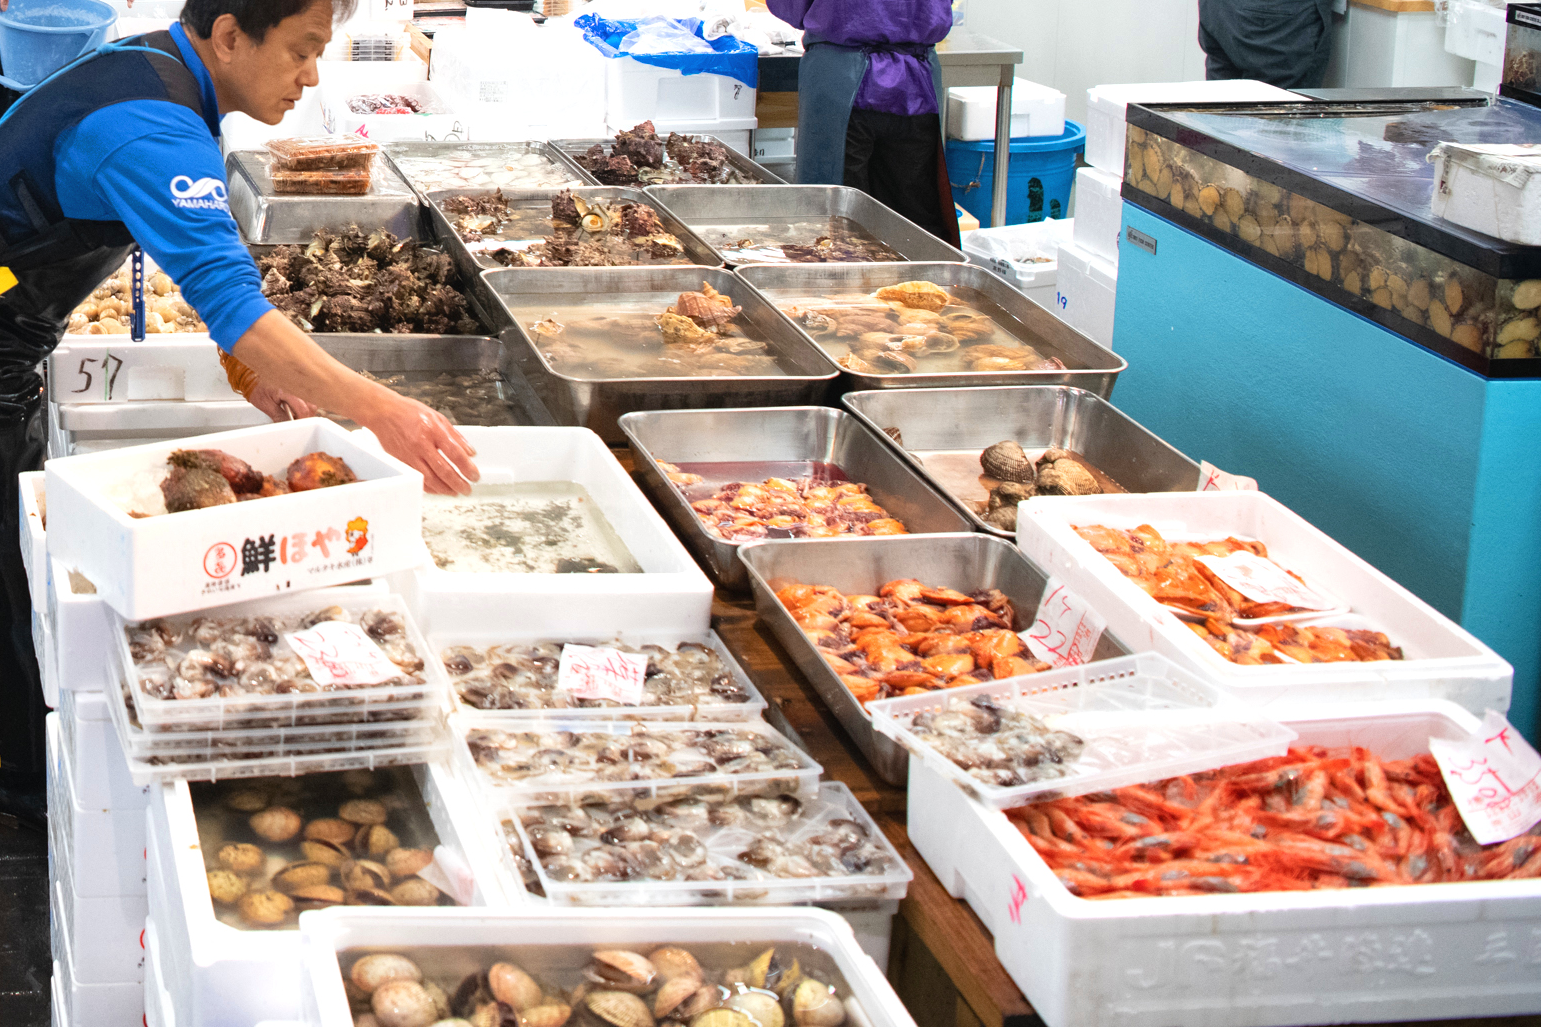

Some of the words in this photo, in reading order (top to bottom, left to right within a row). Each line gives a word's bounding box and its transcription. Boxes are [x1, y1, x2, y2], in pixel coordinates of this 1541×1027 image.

[1056, 291, 1068, 310] 19
[71, 353, 123, 400] 57
[241, 526, 342, 577] 鮮ほや
